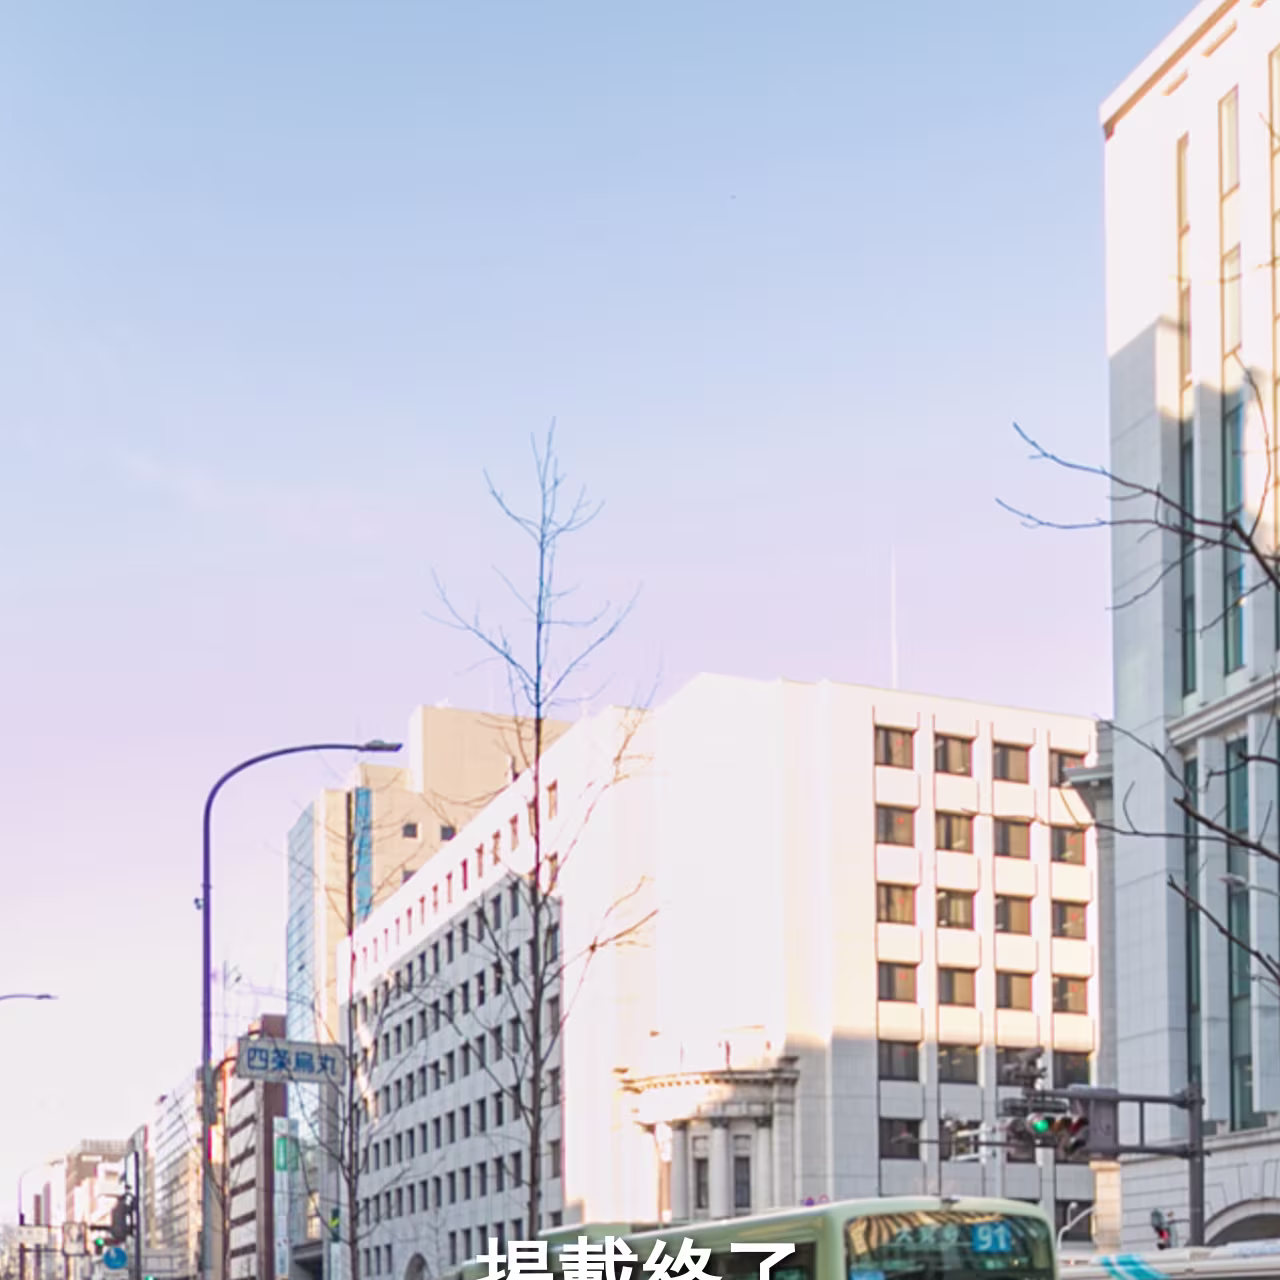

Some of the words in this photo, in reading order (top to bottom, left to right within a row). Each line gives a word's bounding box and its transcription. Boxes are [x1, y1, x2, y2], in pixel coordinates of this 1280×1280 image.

[247, 1046, 337, 1076] 四条烏丸
[977, 1225, 1008, 1250] 91
